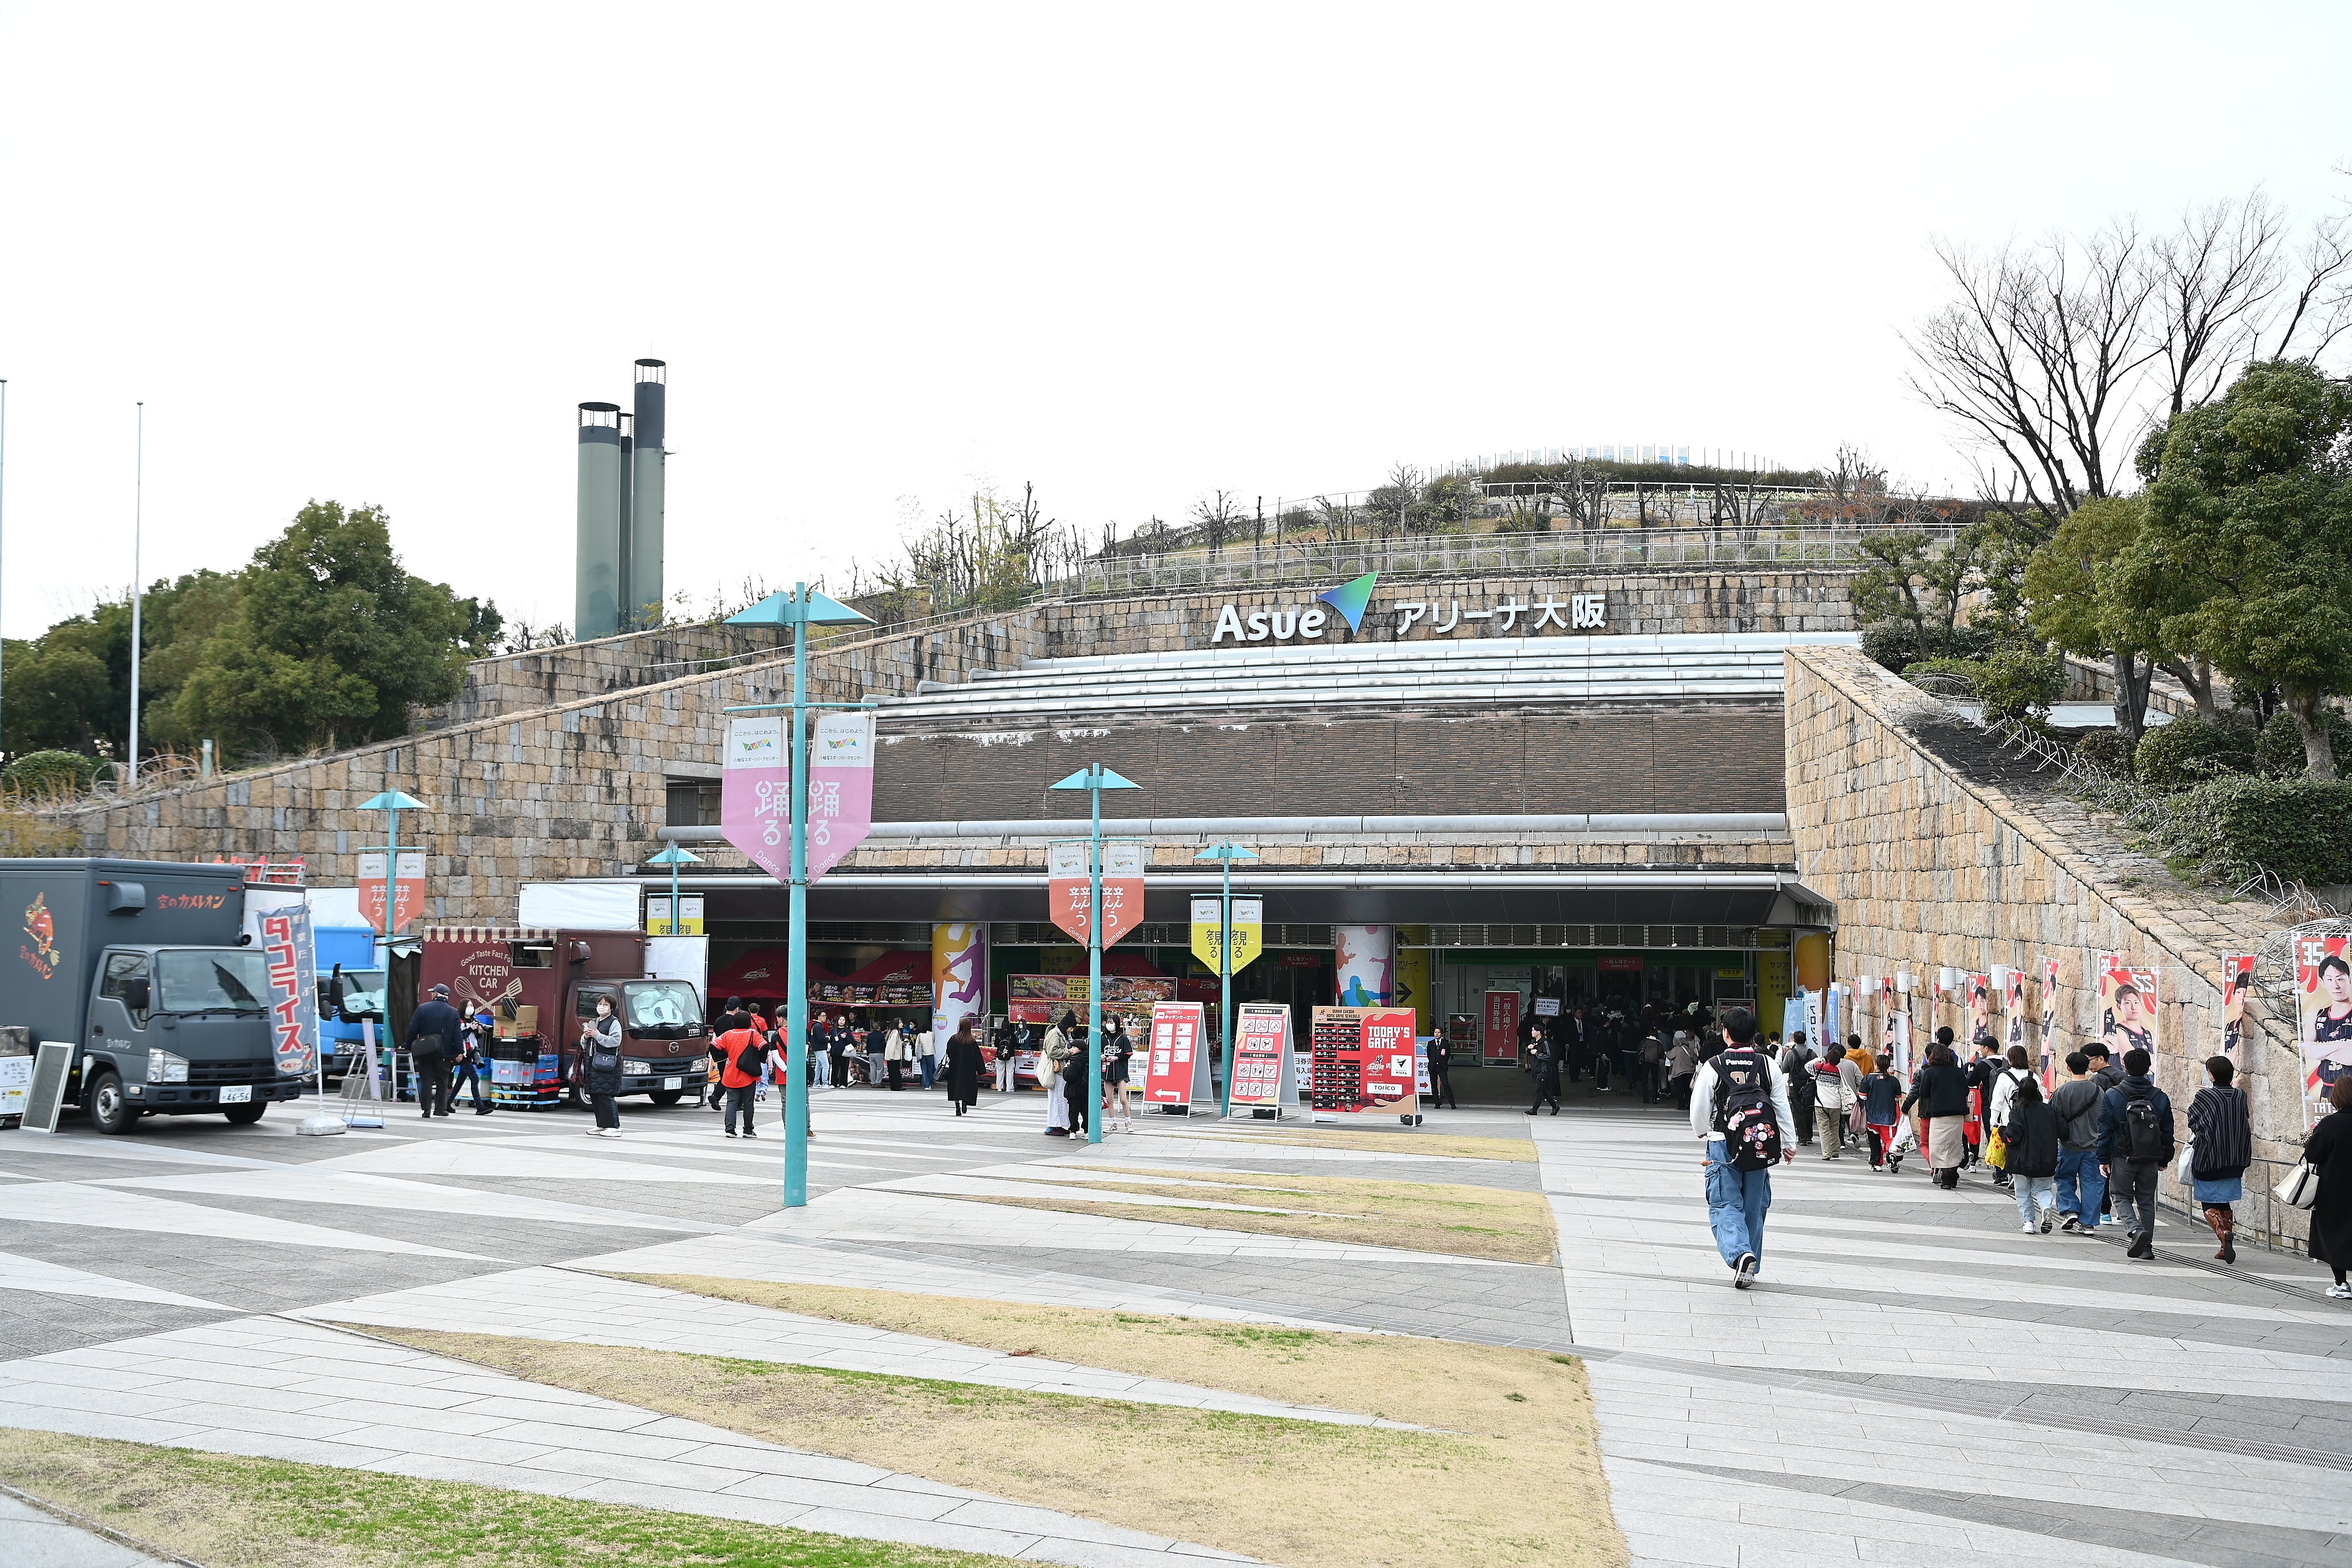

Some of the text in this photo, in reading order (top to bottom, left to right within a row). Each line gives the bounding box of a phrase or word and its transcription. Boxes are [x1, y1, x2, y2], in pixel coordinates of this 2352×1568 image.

[1395, 594, 1606, 636] アリーナ大阪
[1211, 604, 1327, 643] Asue
[756, 850, 780, 874] Dance
[813, 852, 836, 874] Dance
[157, 894, 226, 909] 空のカメレオン
[1104, 927, 1127, 945] Compete
[461, 953, 476, 967] Good
[476, 950, 490, 958] Taste
[492, 950, 503, 959] Fast
[2301, 941, 2325, 967] 35
[469, 964, 509, 977] KITCHEN
[1233, 961, 1245, 971] Watch
[2226, 961, 2239, 982] 31
[265, 915, 304, 1054] タコライス
[479, 977, 498, 988] CAR
[1013, 979, 1041, 988] たこ焼き
[1968, 977, 1977, 993] 12
[1012, 1003, 1052, 1014] ベビーカステラ
[1492, 995, 1501, 1031] 当日券売場
[1368, 1026, 1410, 1038] TODAY'S
[1368, 1037, 1397, 1049] GAME
[227, 1092, 249, 1101] 46-56
[2313, 1102, 2337, 1114] TATS
